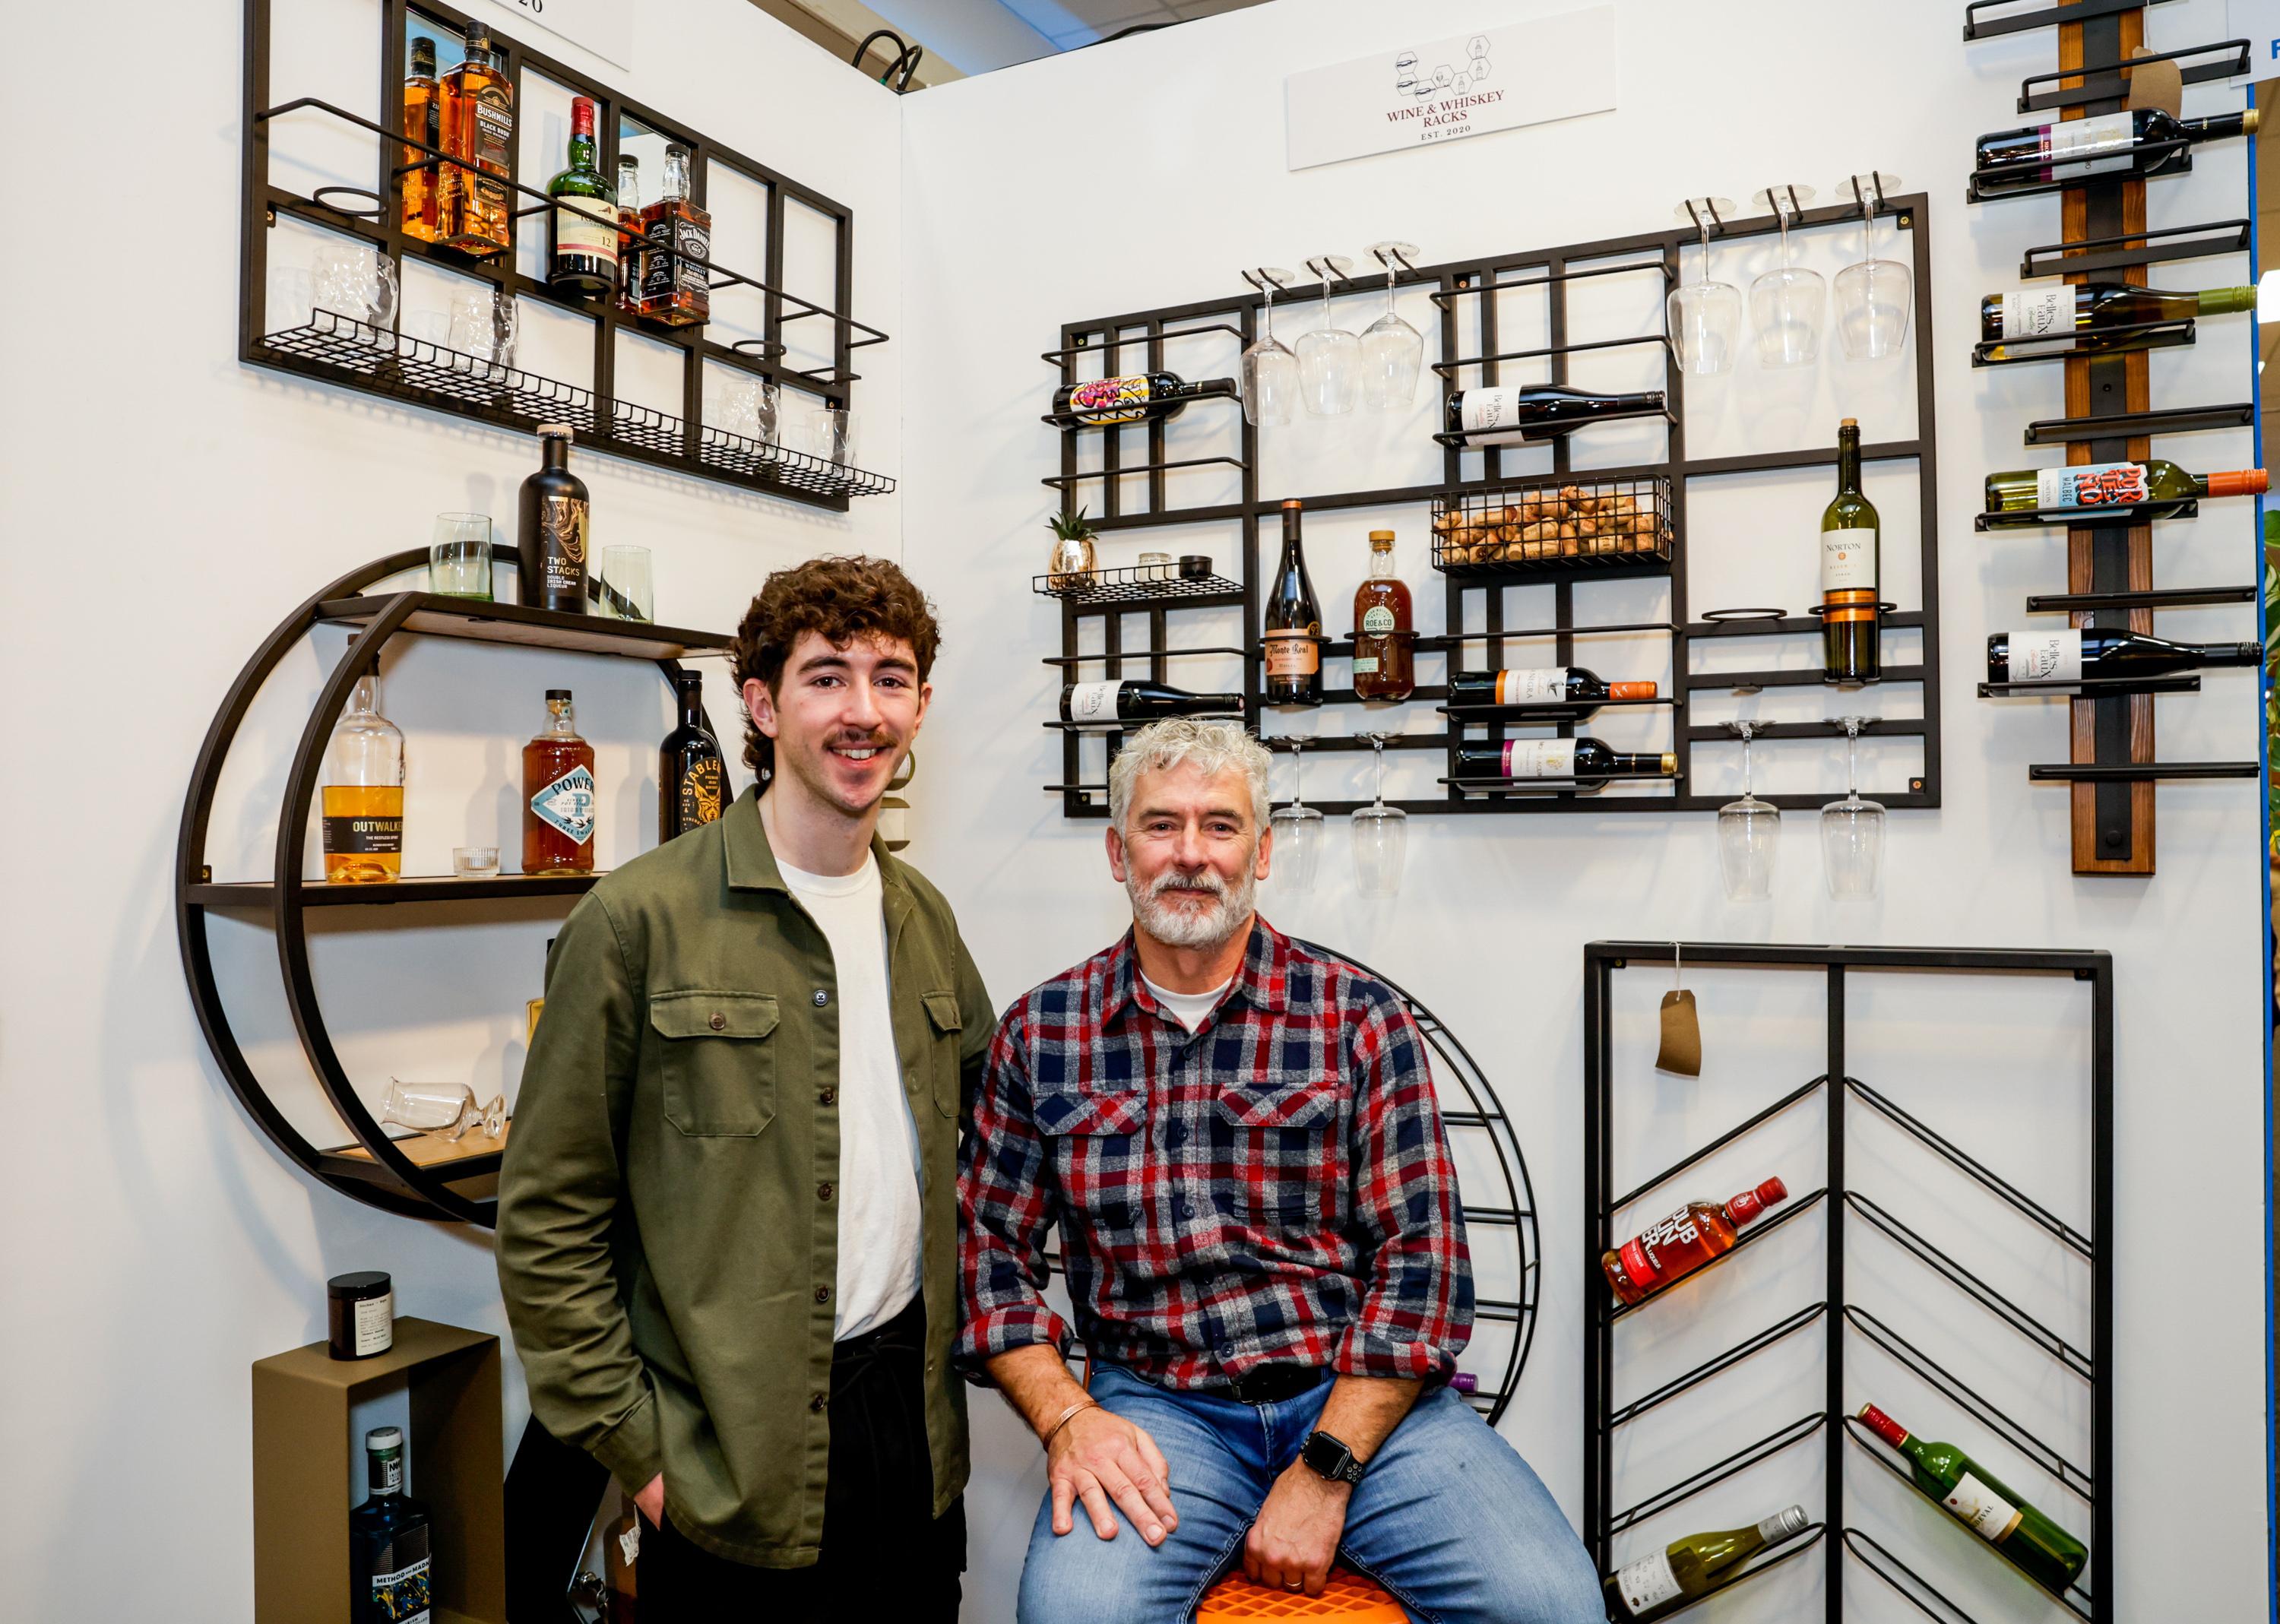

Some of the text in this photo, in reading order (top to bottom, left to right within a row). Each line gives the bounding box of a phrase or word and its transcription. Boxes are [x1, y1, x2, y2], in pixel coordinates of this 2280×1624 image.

[477, 103, 513, 127] BUSHMILLS
[1386, 90, 1504, 122] WINE & WHISKEY
[1423, 109, 1468, 128] RACKS
[480, 120, 510, 138] BLACK BUSH
[1420, 125, 1471, 141] EST. 2020
[602, 236, 611, 247] 12
[679, 228, 694, 240] JACK
[2046, 294, 2057, 325] Belles
[2062, 476, 2073, 502] MALBEC
[1826, 543, 1861, 552] NORTON
[547, 556, 567, 565] TWO
[546, 565, 580, 576] STACKS
[1270, 643, 1308, 657] Monte Real
[2049, 639, 2060, 670] Belles
[1672, 1205, 1699, 1245] DUB
[1976, 1505, 1994, 1527] DEVAL
[376, 1572, 405, 1584] METHOD
